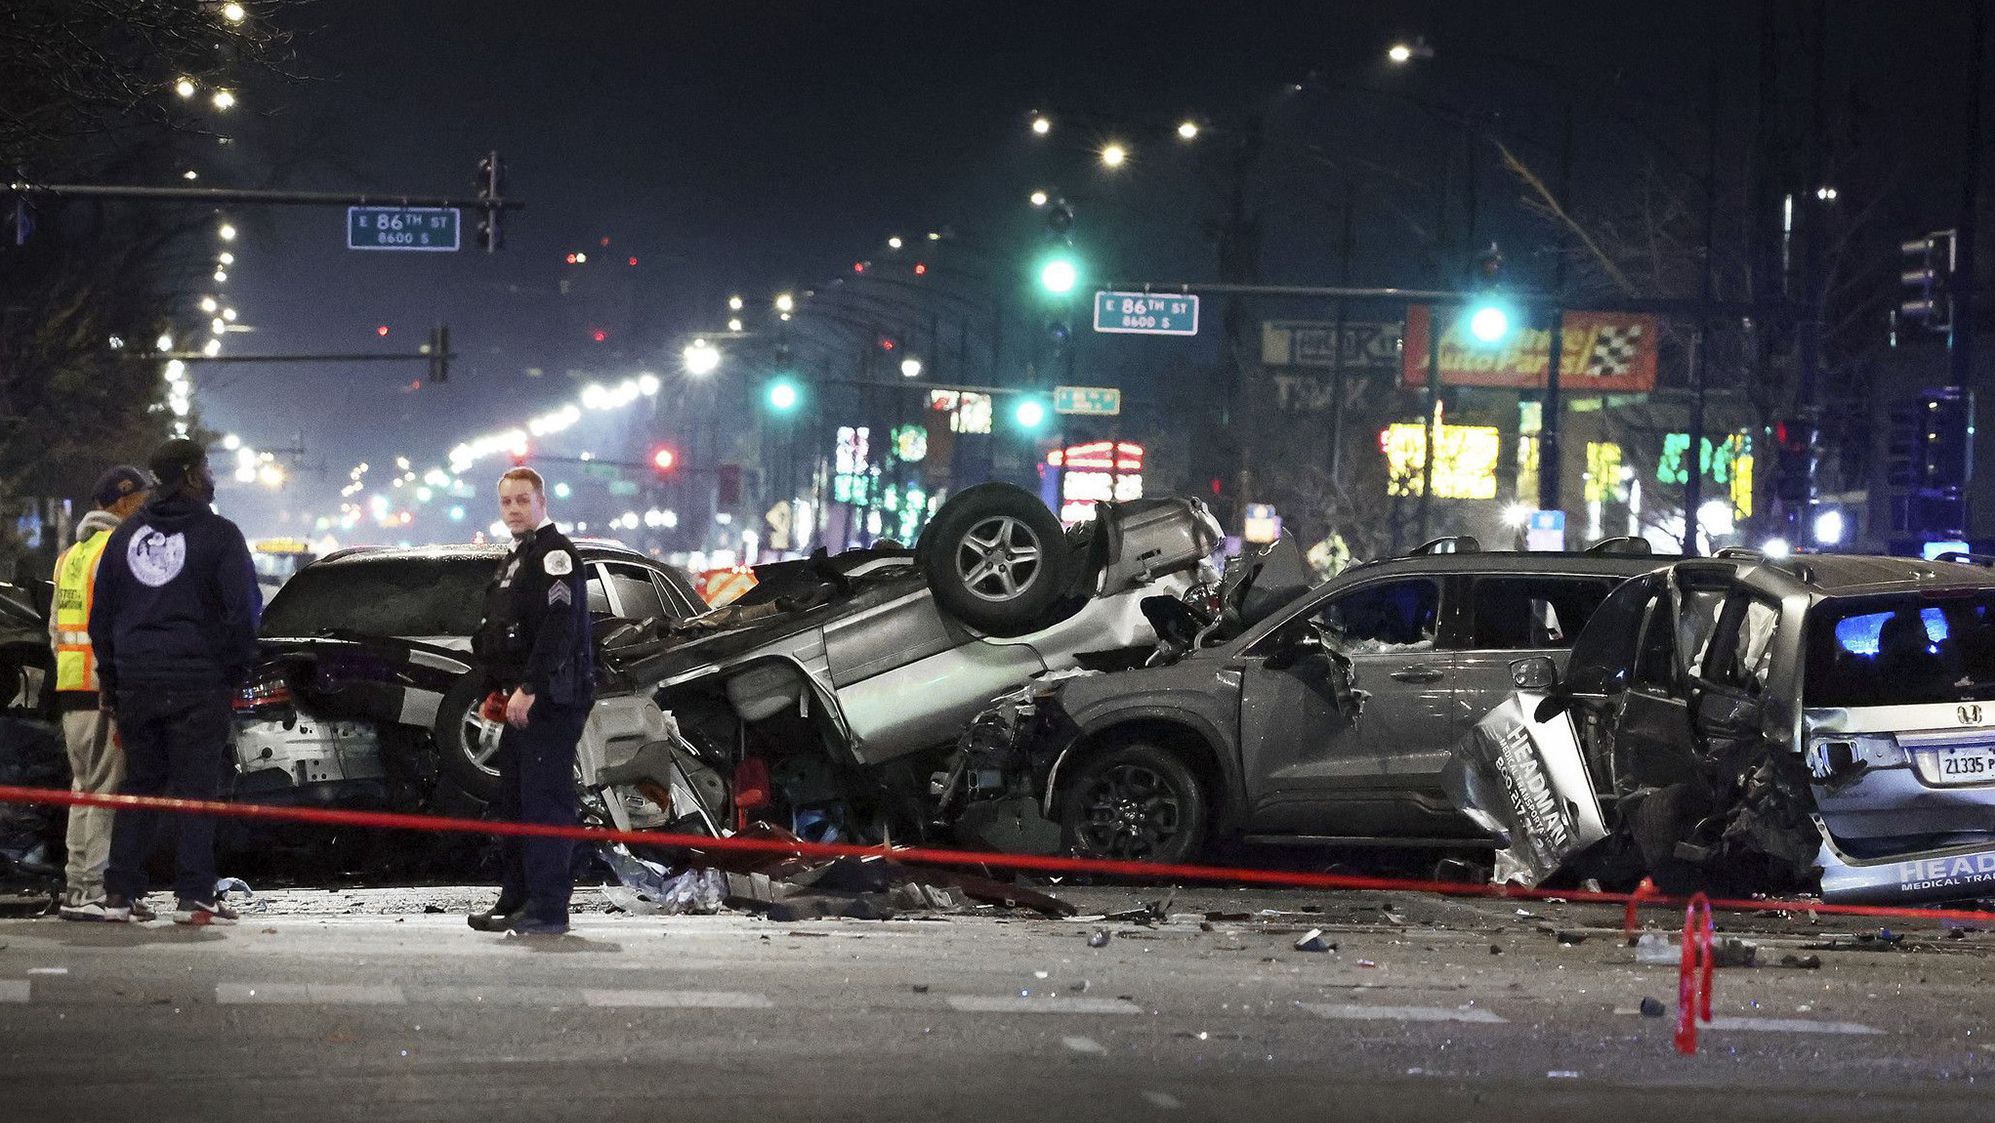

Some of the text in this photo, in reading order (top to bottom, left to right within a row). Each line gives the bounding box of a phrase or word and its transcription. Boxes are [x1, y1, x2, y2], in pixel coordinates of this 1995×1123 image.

[359, 213, 447, 230] E 86TH ST
[378, 232, 429, 244] 8600 S
[1106, 298, 1188, 315] E 86TH ST
[1122, 316, 1170, 329] 8600 S
[1500, 738, 1518, 776] MEDICAL
[1945, 757, 1984, 774] 21335
[1507, 723, 1567, 847] HEADMAN
[1901, 874, 1995, 891] MEDICAL TRA
